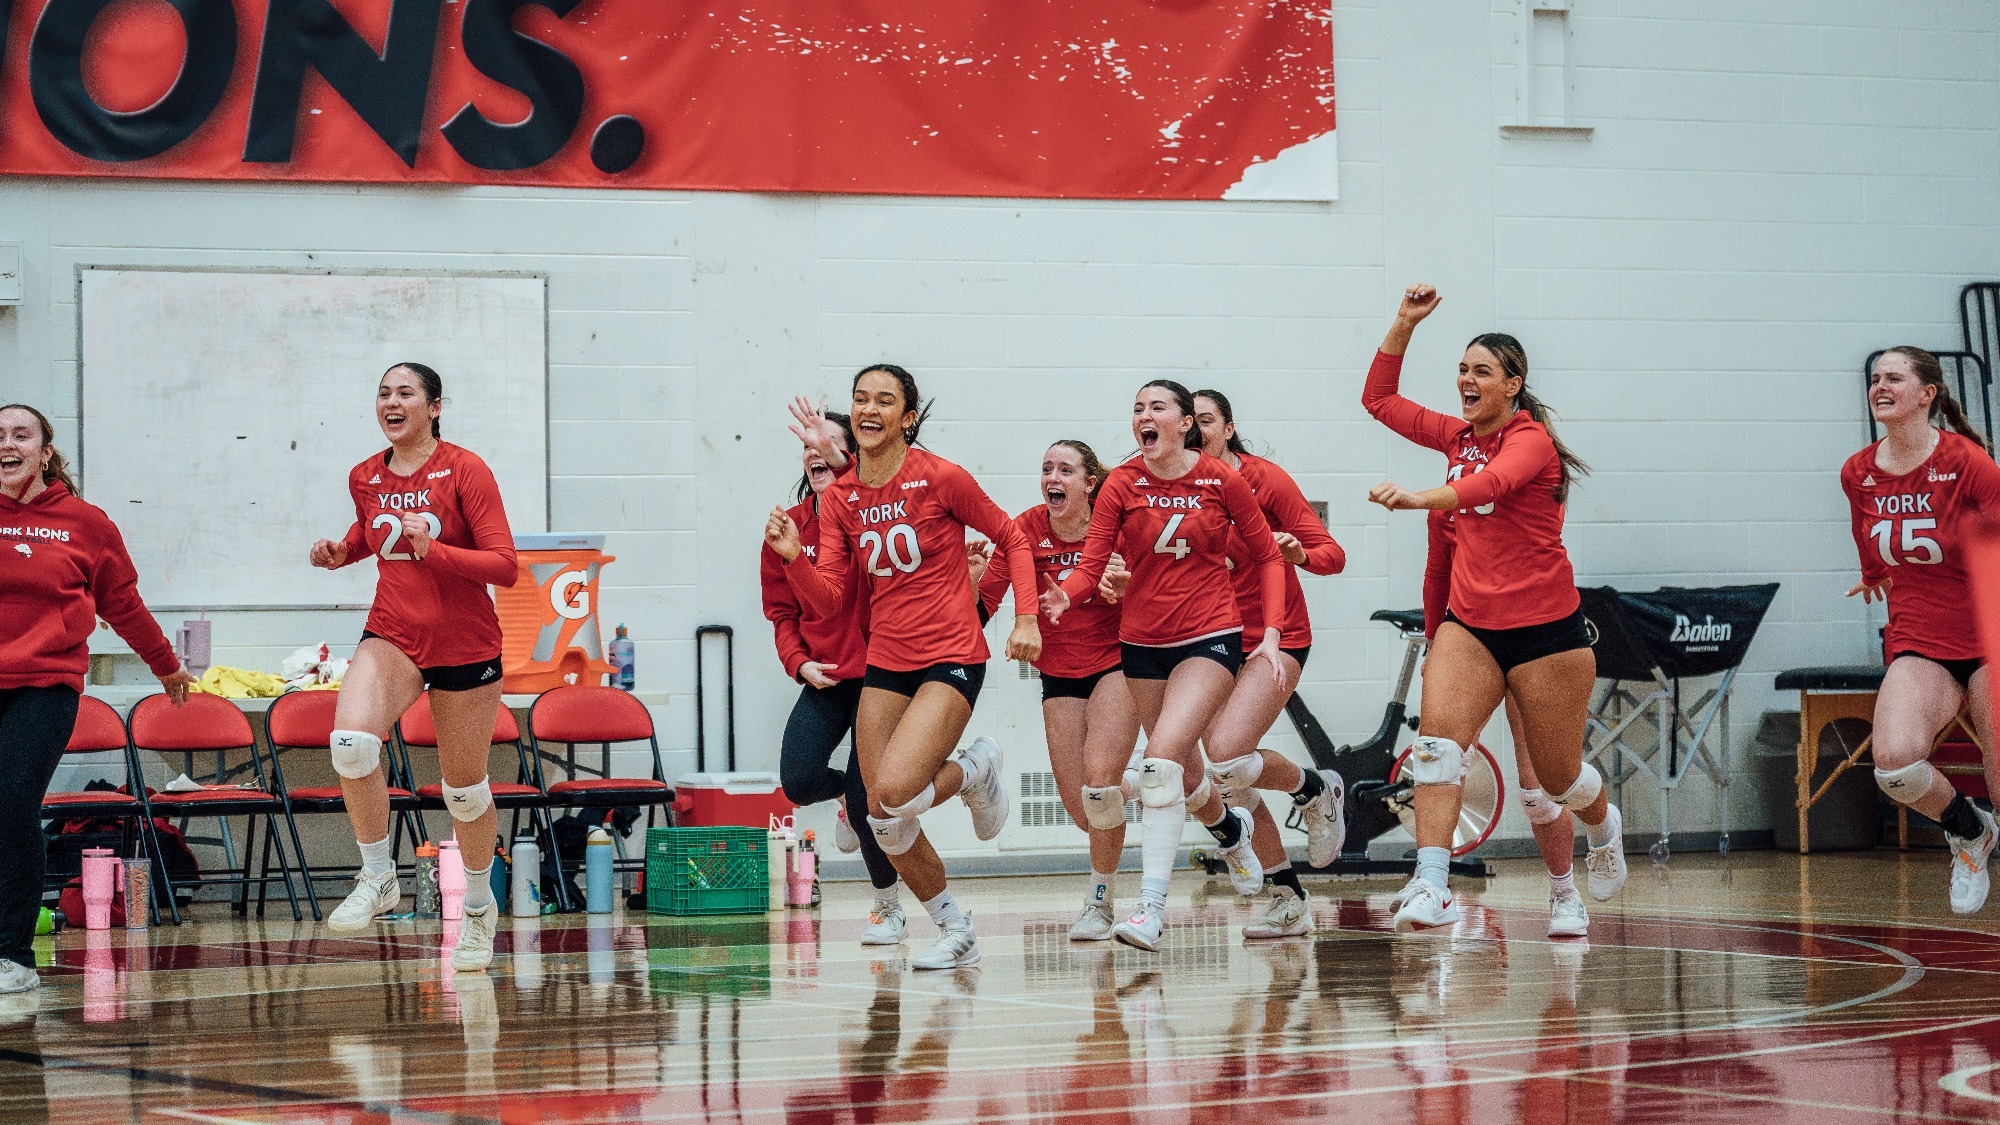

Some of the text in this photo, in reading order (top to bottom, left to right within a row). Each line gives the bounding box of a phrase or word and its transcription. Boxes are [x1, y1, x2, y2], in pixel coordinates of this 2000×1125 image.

[0, 0, 644, 174] ONS.
[901, 479, 928, 490] OUA
[1194, 478, 1222, 486] OUA
[377, 488, 432, 509] YORK
[1145, 494, 1202, 509] YORK
[1874, 493, 1933, 515] YORK
[859, 500, 908, 526] YORK
[26, 526, 70, 542] LIONS
[1153, 513, 1192, 560] 4
[1869, 517, 1944, 566] 15
[859, 523, 922, 577] 20
[551, 569, 590, 620] G
[1670, 614, 1732, 642] Baden
